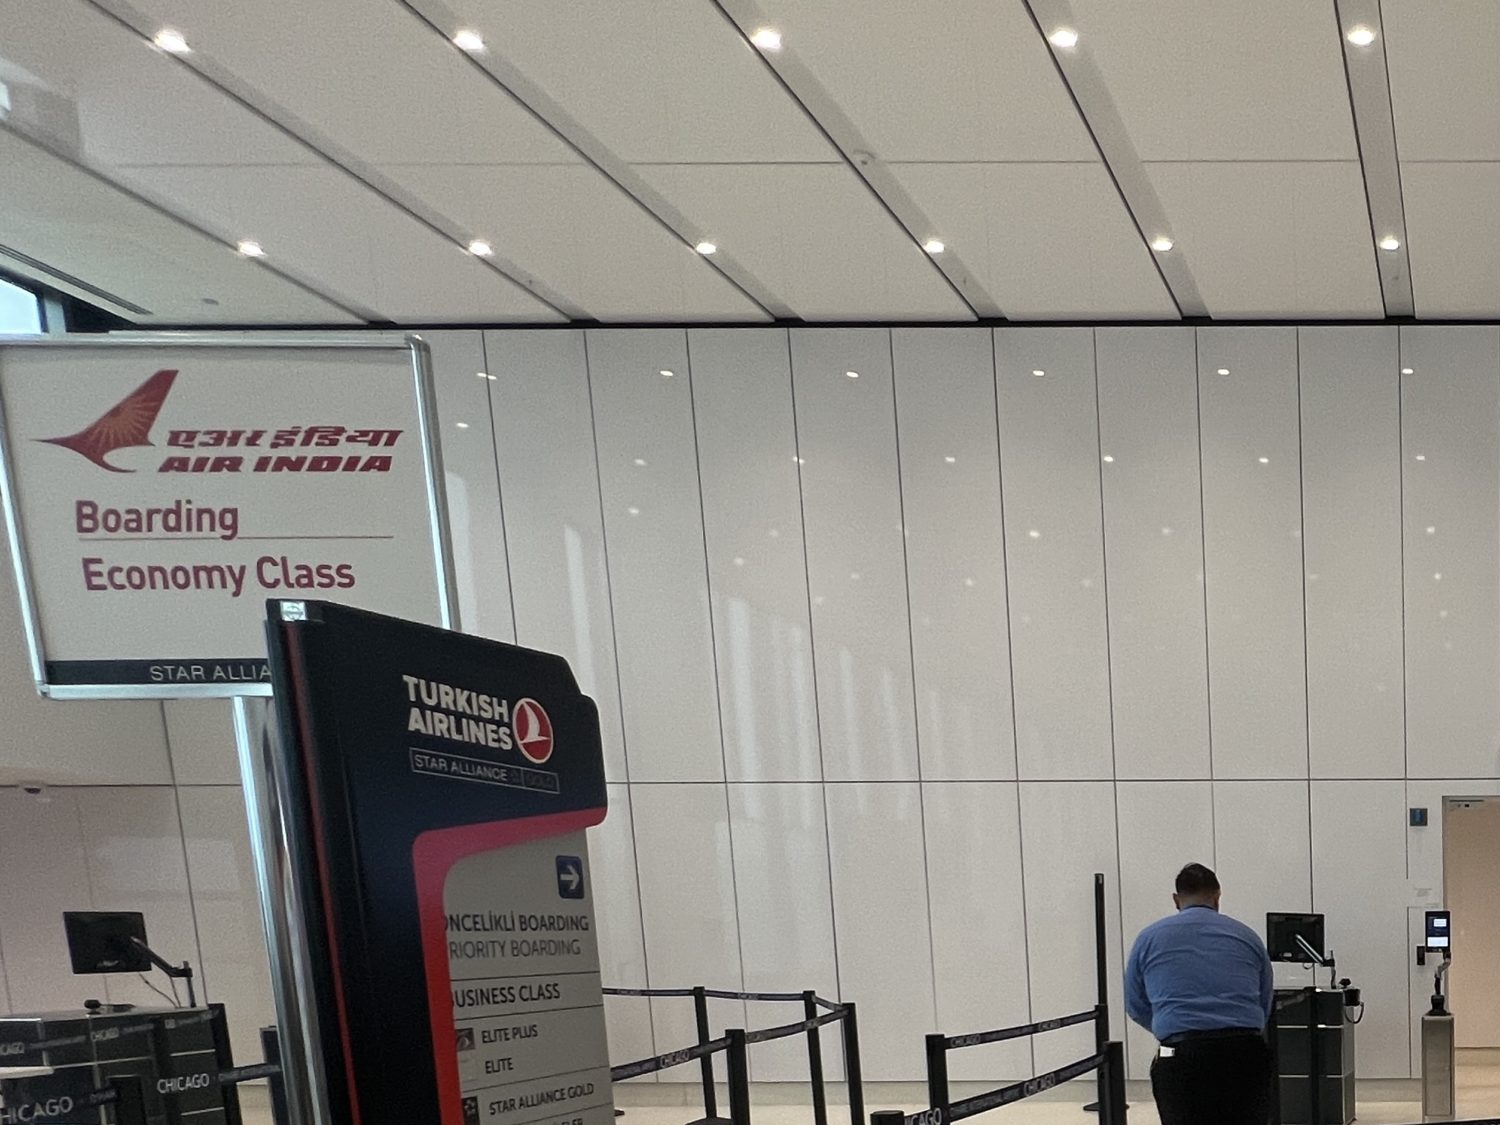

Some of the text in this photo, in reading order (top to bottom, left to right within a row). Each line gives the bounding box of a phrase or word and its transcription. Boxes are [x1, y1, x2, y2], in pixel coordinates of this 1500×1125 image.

[270, 425, 404, 449] इंडिया
[158, 455, 393, 473] AIR INDIA
[75, 499, 239, 540] Boarding
[82, 555, 355, 597] Economy Class
[150, 664, 272, 682] STAR ALLIA
[402, 674, 509, 722] TURKISH
[408, 707, 512, 750] AIRLINES
[415, 754, 448, 771] STAR
[451, 758, 507, 781] ALLIANCE
[445, 910, 588, 931] NCELİKLİ BOARDING
[450, 939, 581, 959] RIORITY BOARDING
[455, 983, 560, 1007] USINESS CLASS
[482, 1025, 538, 1043] ELITE PLUS
[485, 1058, 513, 1074] ELITE
[157, 1073, 210, 1094] CHICAGO
[0, 1097, 73, 1124] HICAGO
[489, 1083, 594, 1115] STAR ALLIANCE GOLD
